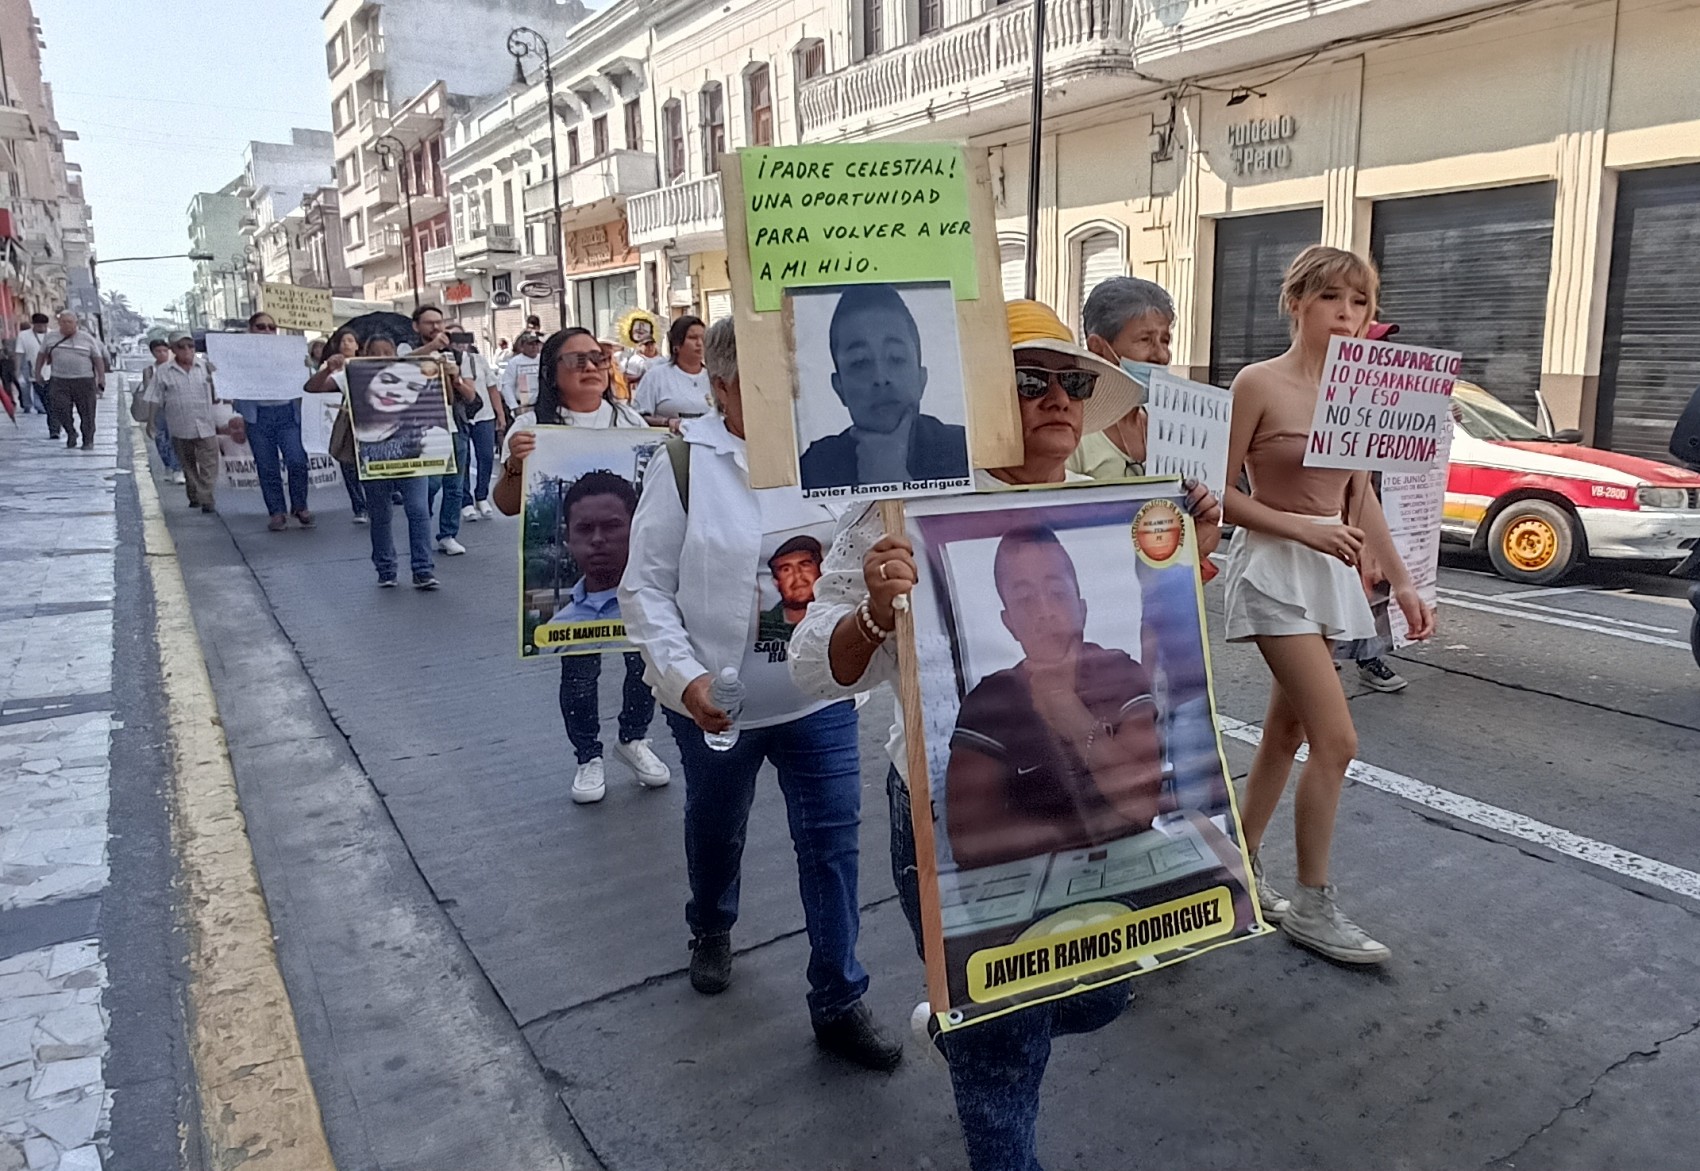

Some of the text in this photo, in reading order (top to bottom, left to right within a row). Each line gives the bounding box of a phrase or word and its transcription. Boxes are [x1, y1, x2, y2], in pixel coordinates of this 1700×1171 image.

[758, 155, 956, 179] ¡PADRE CELESTIAL!
[752, 188, 940, 212] UNA OPORTUNIDAD
[755, 221, 971, 247] PARA VOLVER A VER
[759, 251, 878, 281] A MI HIJO.
[1338, 341, 1461, 375] NO DESAPARECIO
[1330, 364, 1350, 383] LO
[1325, 385, 1400, 406] N Y ESO
[1325, 404, 1437, 433] NO SE OLVIDA
[1310, 431, 1437, 462] NI SE PERDONA
[802, 478, 971, 499] Javier Ramos Rodriguez
[1591, 485, 1628, 500] VB-2800
[548, 626, 571, 642] JOSÉ
[572, 625, 611, 639] MANUEL
[984, 898, 1222, 990] JAVIER RAMOS RODRIGUEZ
